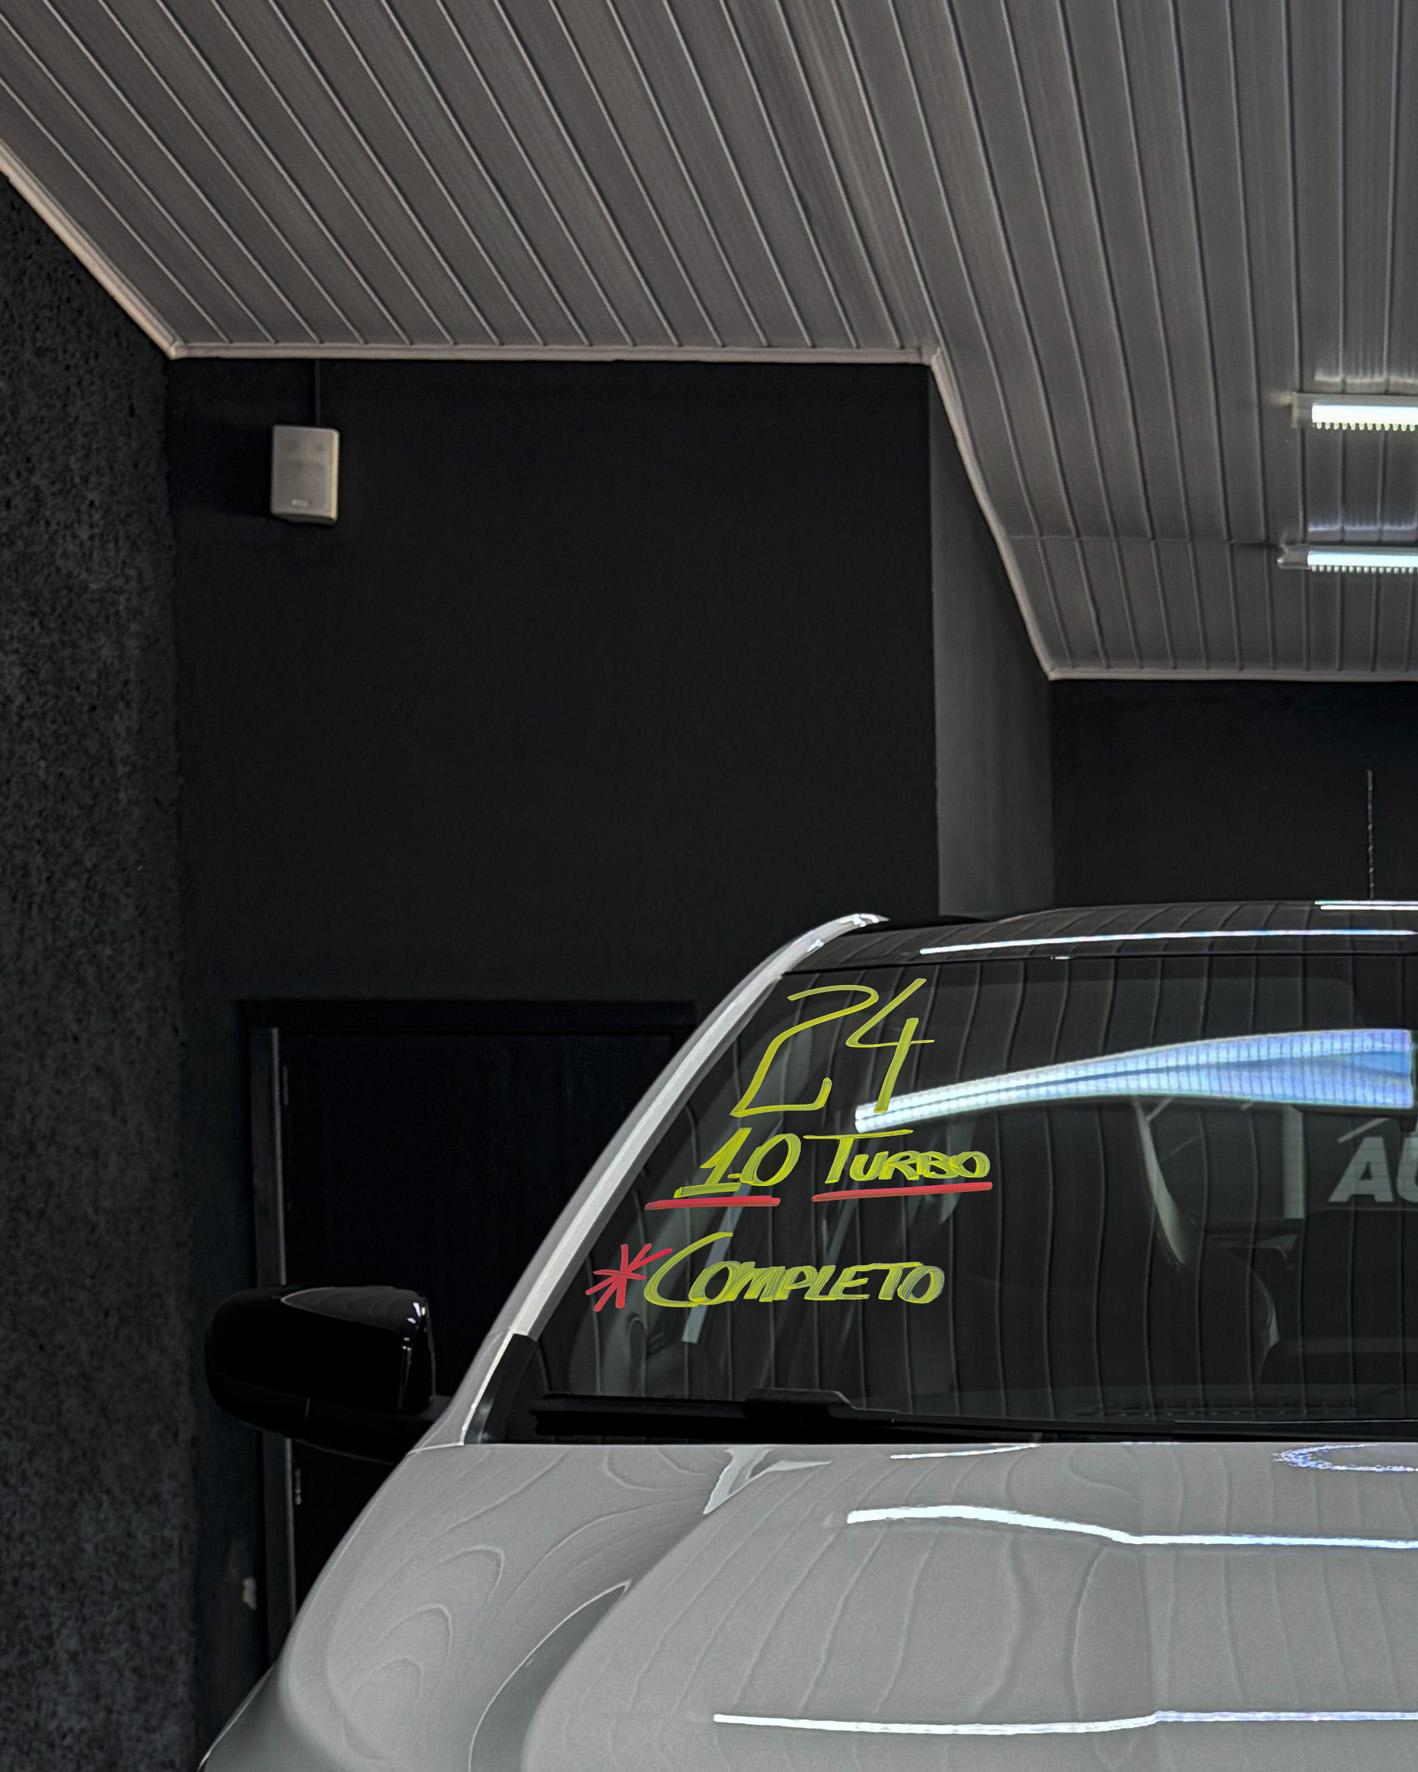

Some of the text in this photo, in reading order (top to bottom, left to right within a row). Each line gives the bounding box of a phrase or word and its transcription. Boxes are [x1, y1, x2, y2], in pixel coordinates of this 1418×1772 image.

[730, 978, 935, 1118] 24
[803, 1129, 991, 1184] TURBO
[643, 1232, 945, 1308] COMPLETO
